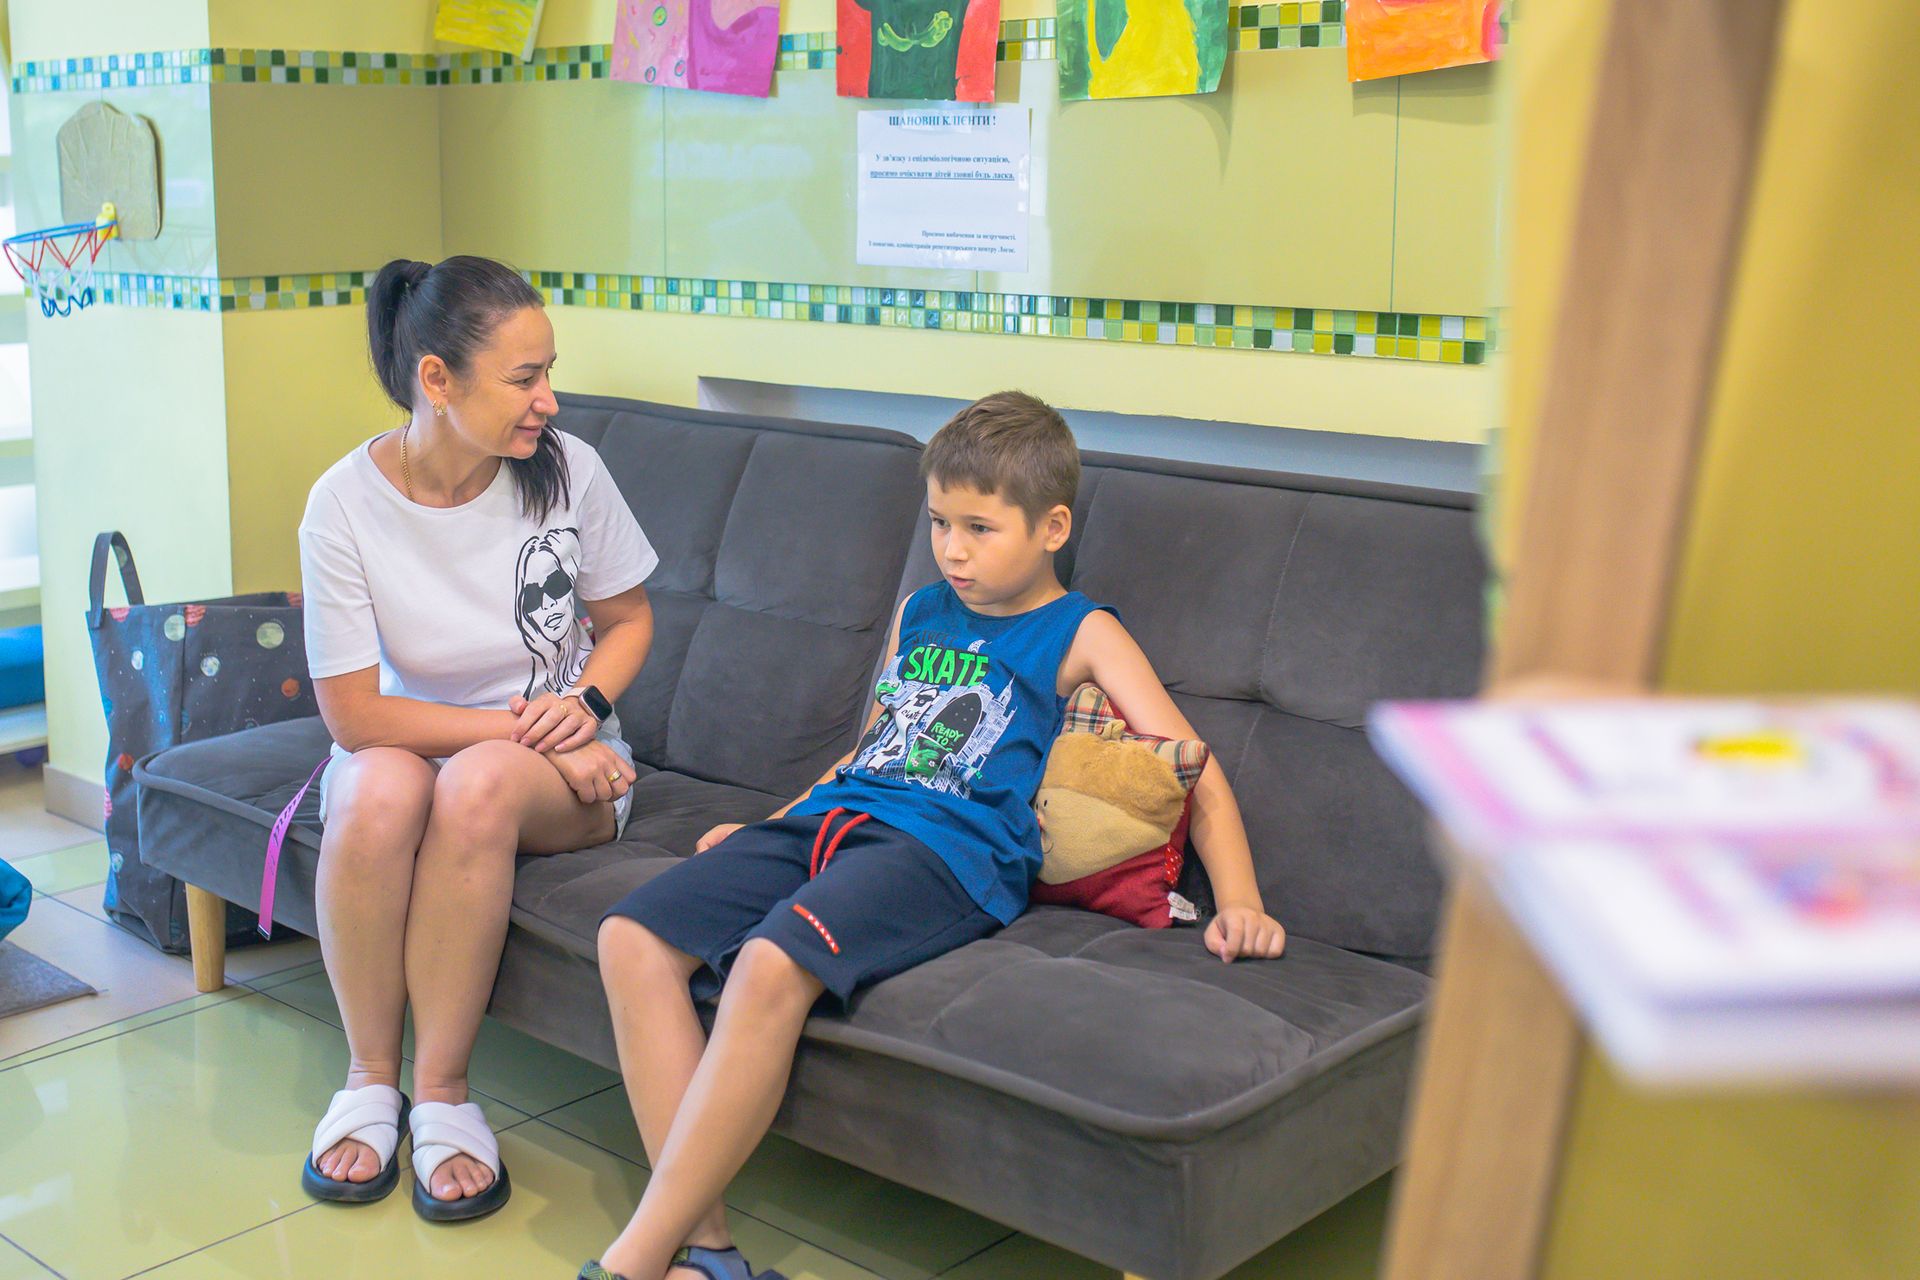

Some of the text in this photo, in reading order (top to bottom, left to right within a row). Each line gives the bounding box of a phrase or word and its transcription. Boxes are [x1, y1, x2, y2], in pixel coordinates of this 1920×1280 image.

[904, 646, 989, 687] SKATE
[930, 721, 965, 743] READY
[936, 735, 949, 746] TO
